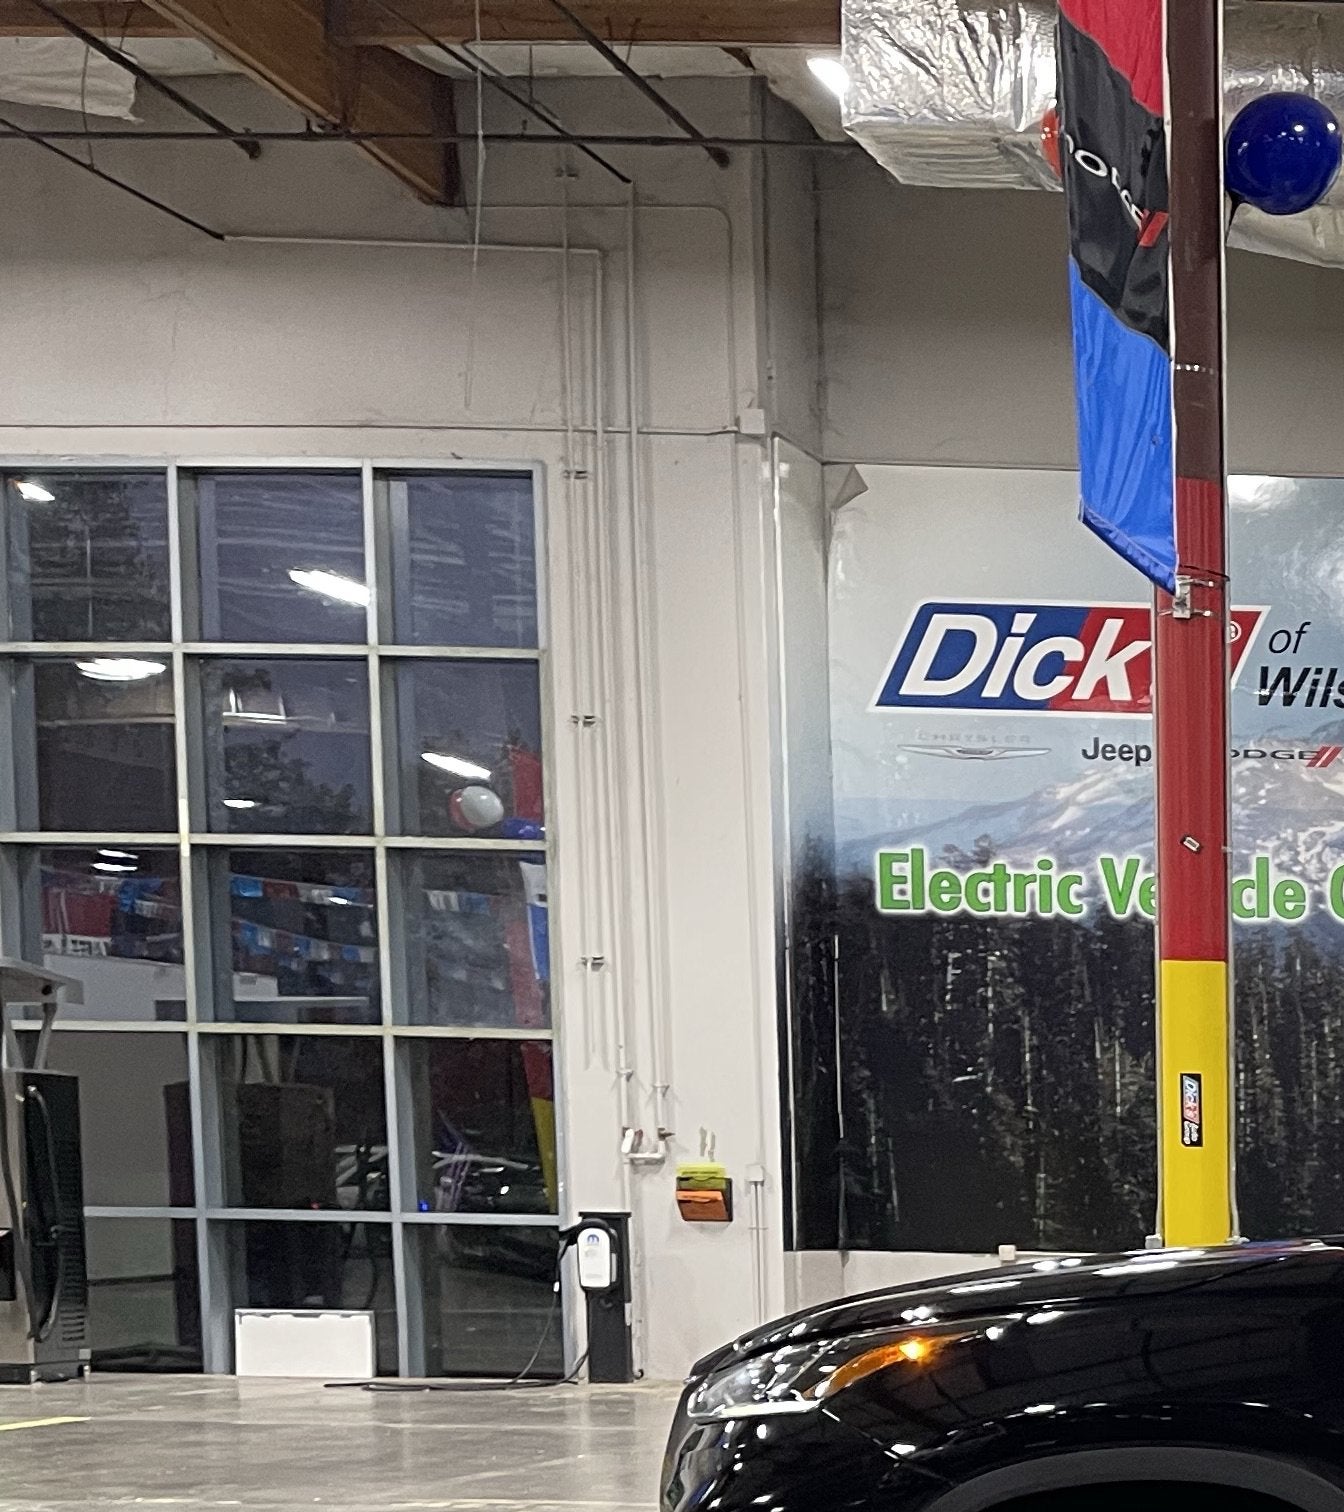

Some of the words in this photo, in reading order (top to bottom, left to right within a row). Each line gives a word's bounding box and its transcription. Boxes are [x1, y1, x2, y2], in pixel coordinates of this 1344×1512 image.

[1268, 621, 1312, 654] of
[1081, 736, 1152, 767] Jeep
[878, 848, 1083, 915] Electric
[1100, 856, 1307, 920] Vecle
